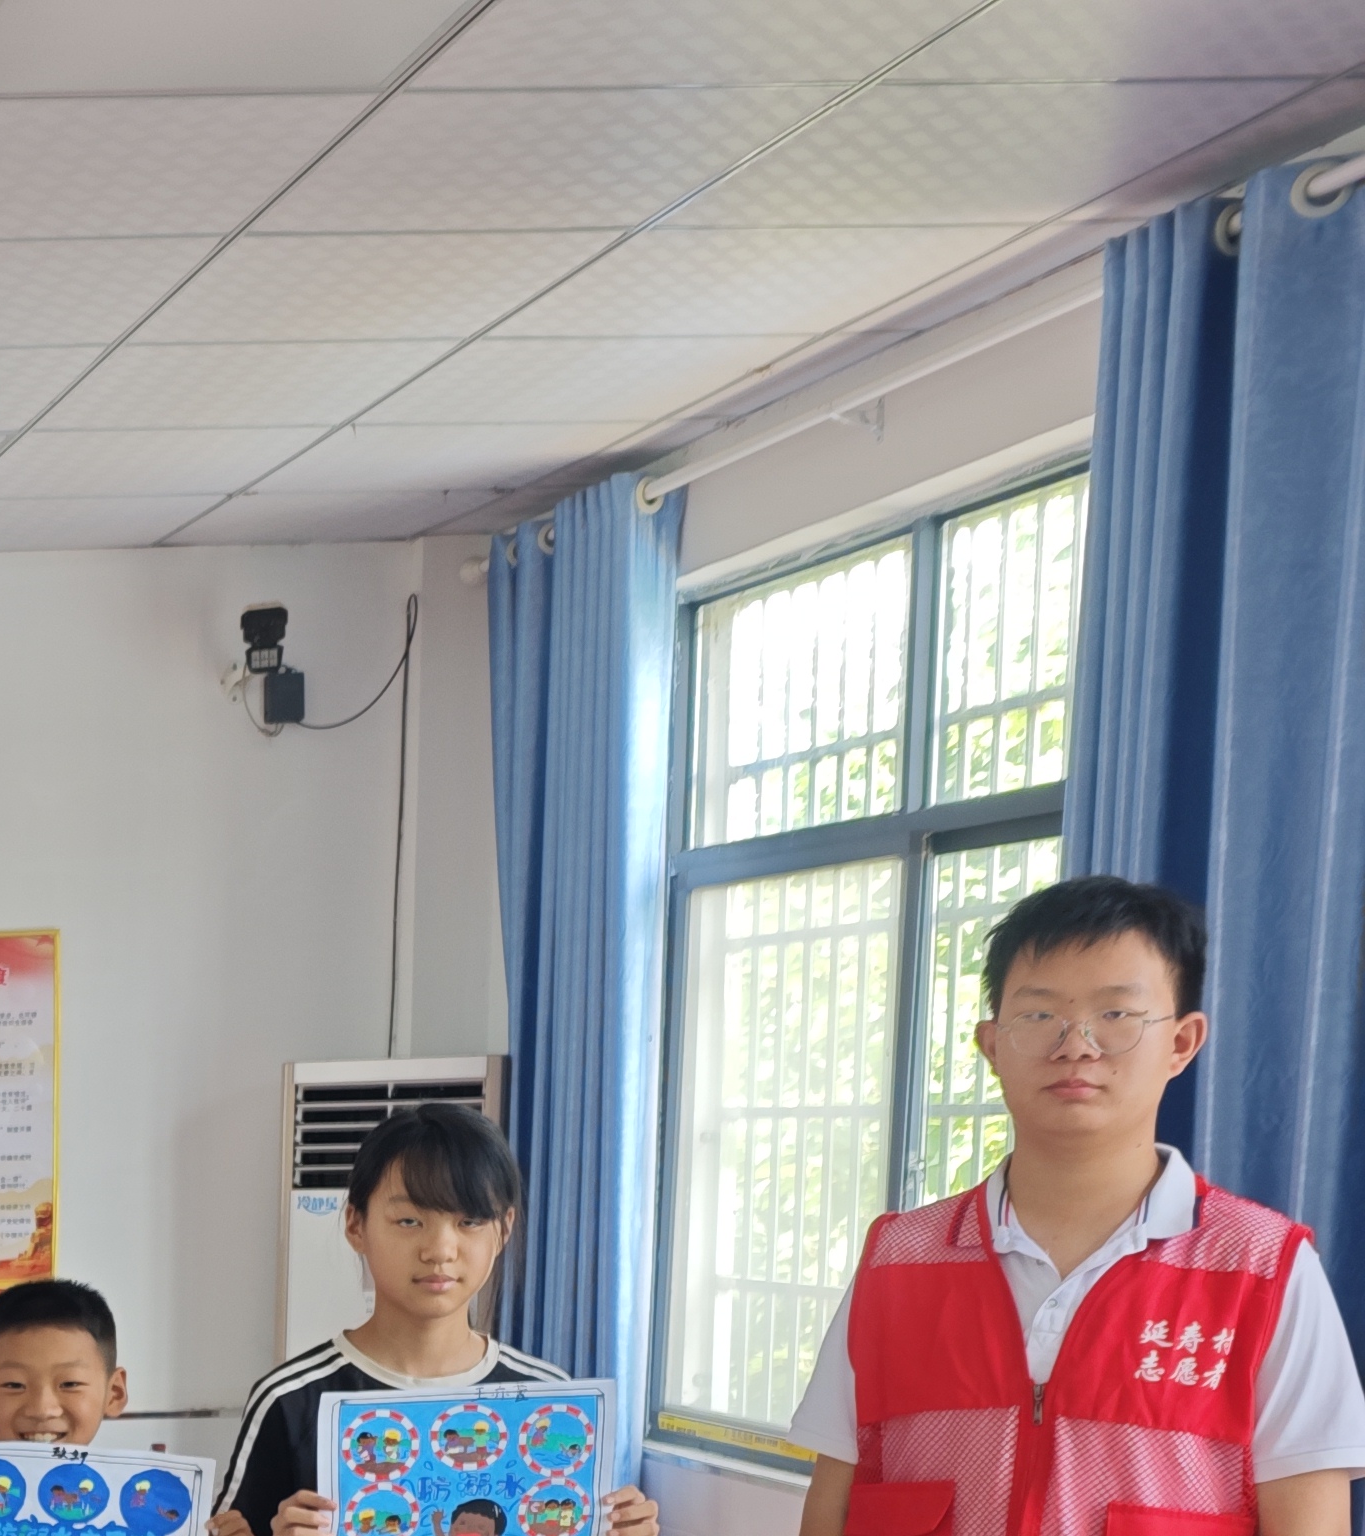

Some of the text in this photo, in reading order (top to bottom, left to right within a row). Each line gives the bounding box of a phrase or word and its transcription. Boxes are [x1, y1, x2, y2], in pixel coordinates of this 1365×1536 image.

[1134, 1350, 1227, 1390] 志愿者
[417, 1472, 527, 1502] 防溺水
